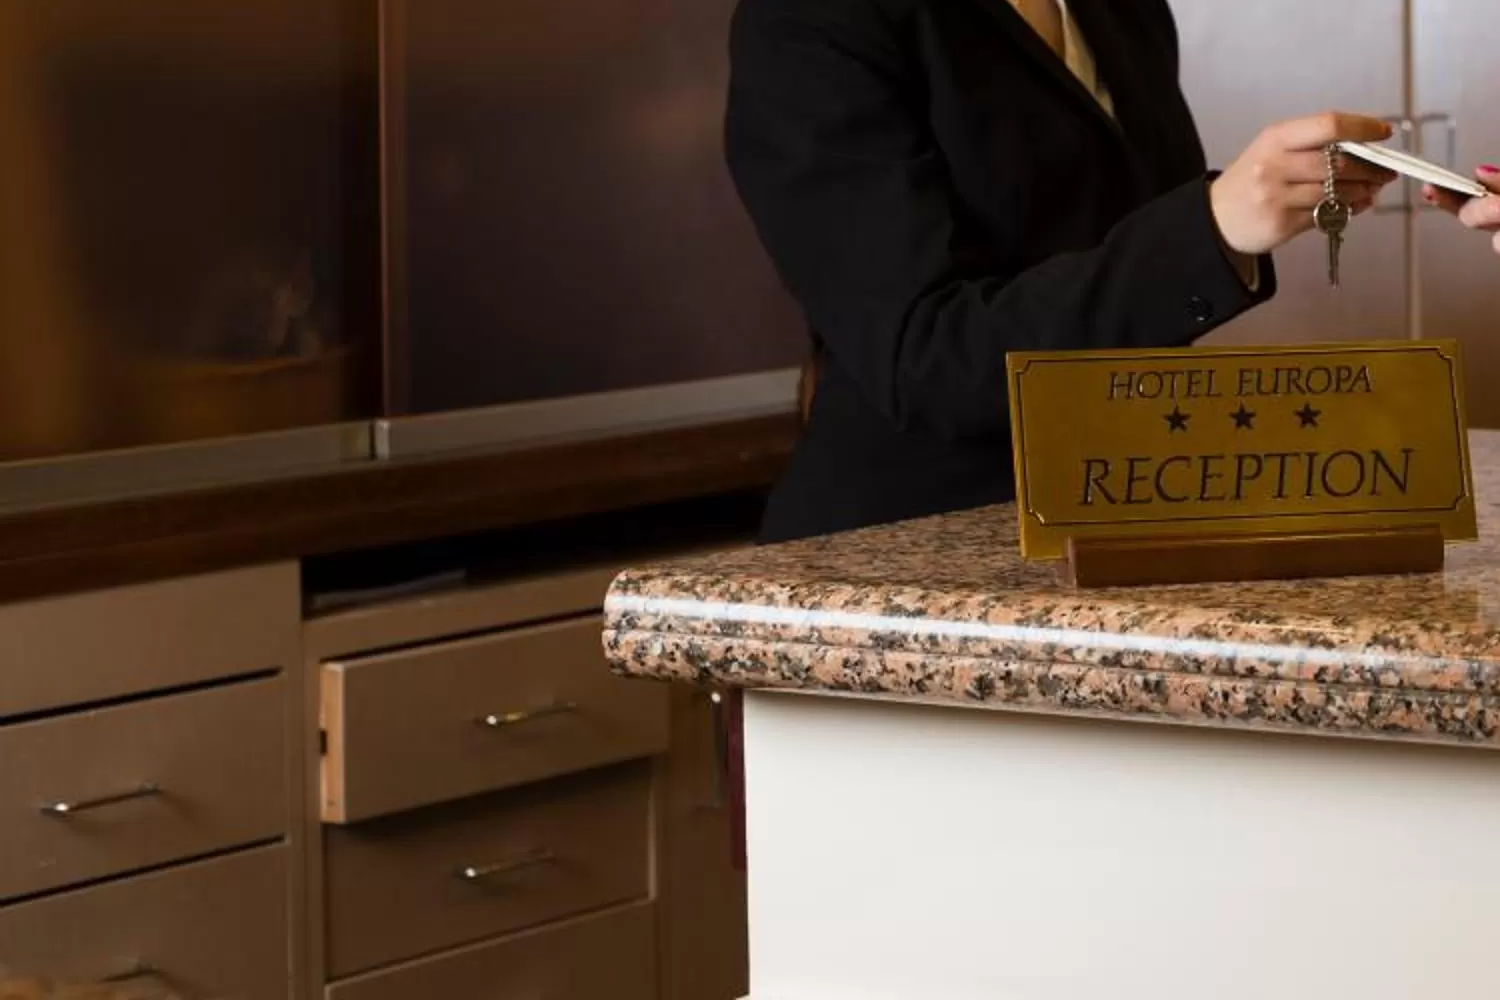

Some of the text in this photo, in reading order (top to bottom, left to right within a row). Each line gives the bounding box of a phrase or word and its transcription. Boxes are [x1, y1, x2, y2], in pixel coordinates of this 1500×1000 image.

[1108, 365, 1373, 401] HOTEL EUROPA
[1079, 447, 1414, 506] RECEPTION
